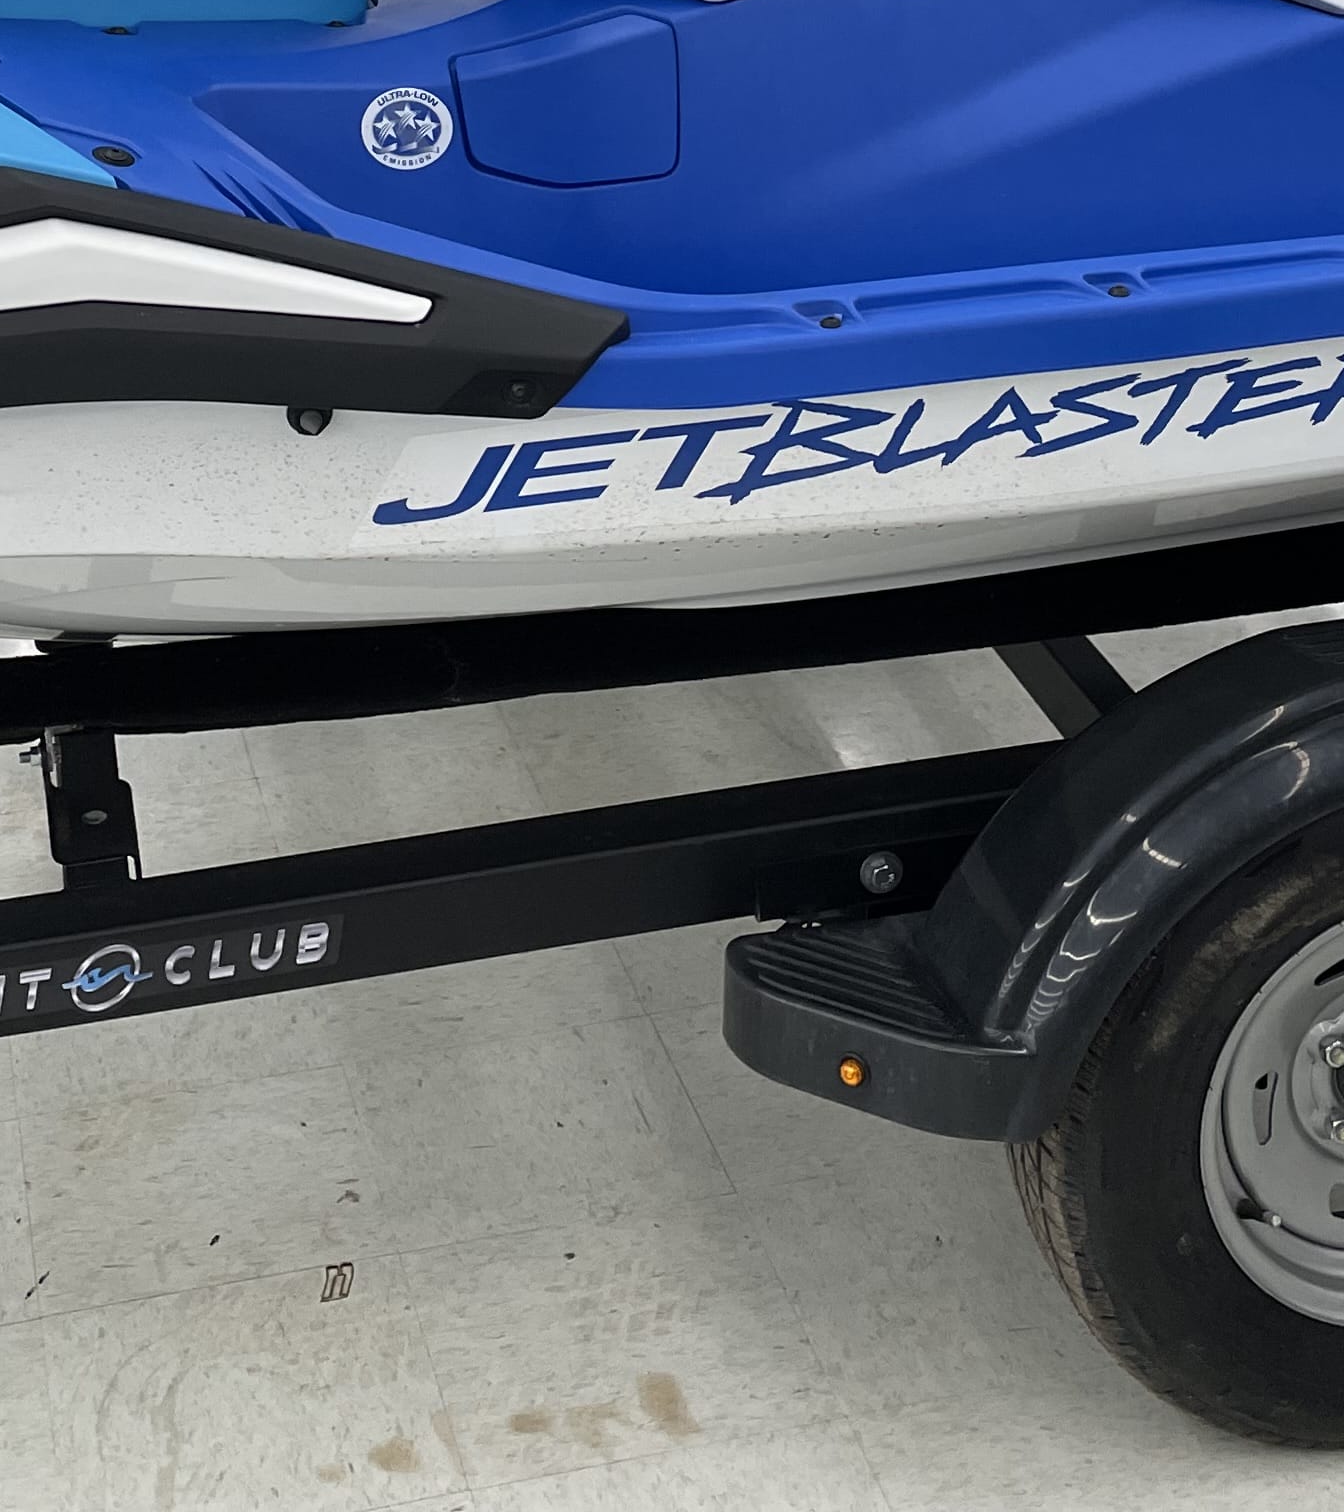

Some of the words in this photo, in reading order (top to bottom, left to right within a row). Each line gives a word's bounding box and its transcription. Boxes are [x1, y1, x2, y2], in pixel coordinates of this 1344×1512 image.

[377, 89, 439, 107] ULTRA-LOW
[382, 154, 432, 167] EMISSION
[164, 921, 331, 986] CLUB
